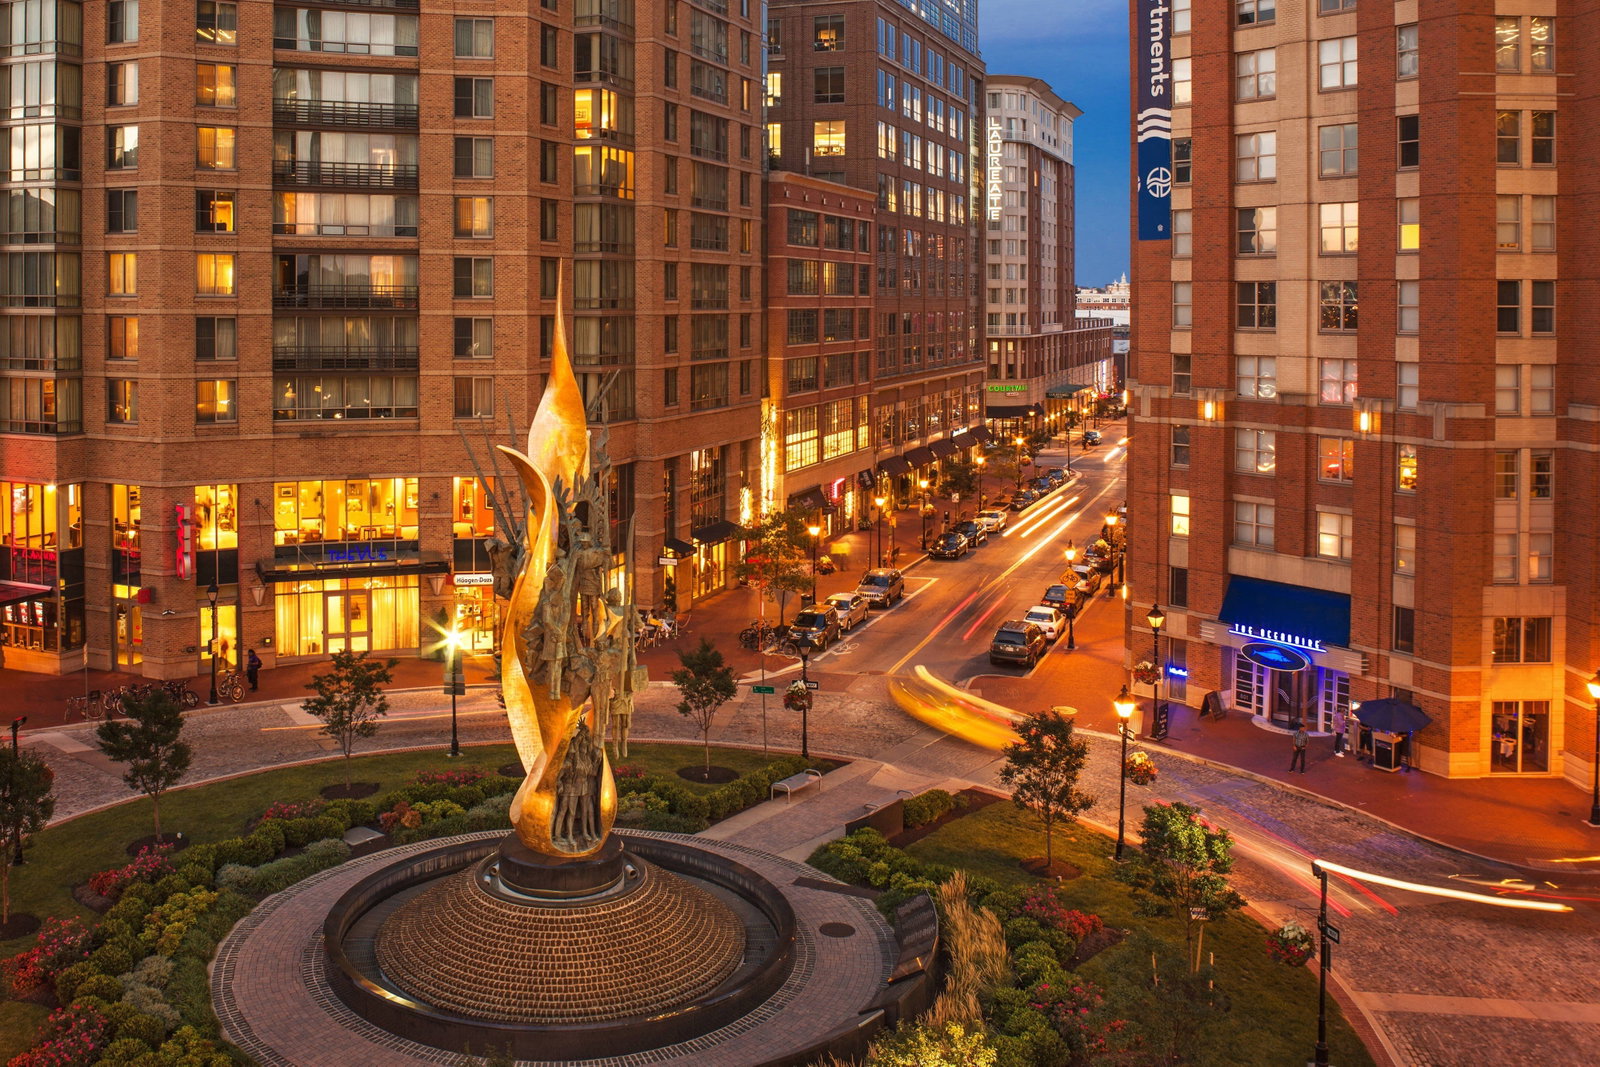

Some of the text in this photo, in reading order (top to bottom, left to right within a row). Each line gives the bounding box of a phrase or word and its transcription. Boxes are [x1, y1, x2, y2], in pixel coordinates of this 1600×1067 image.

[990, 117, 1002, 220] LAUREATE
[1235, 623, 1320, 649] THE OCEANAIRE
